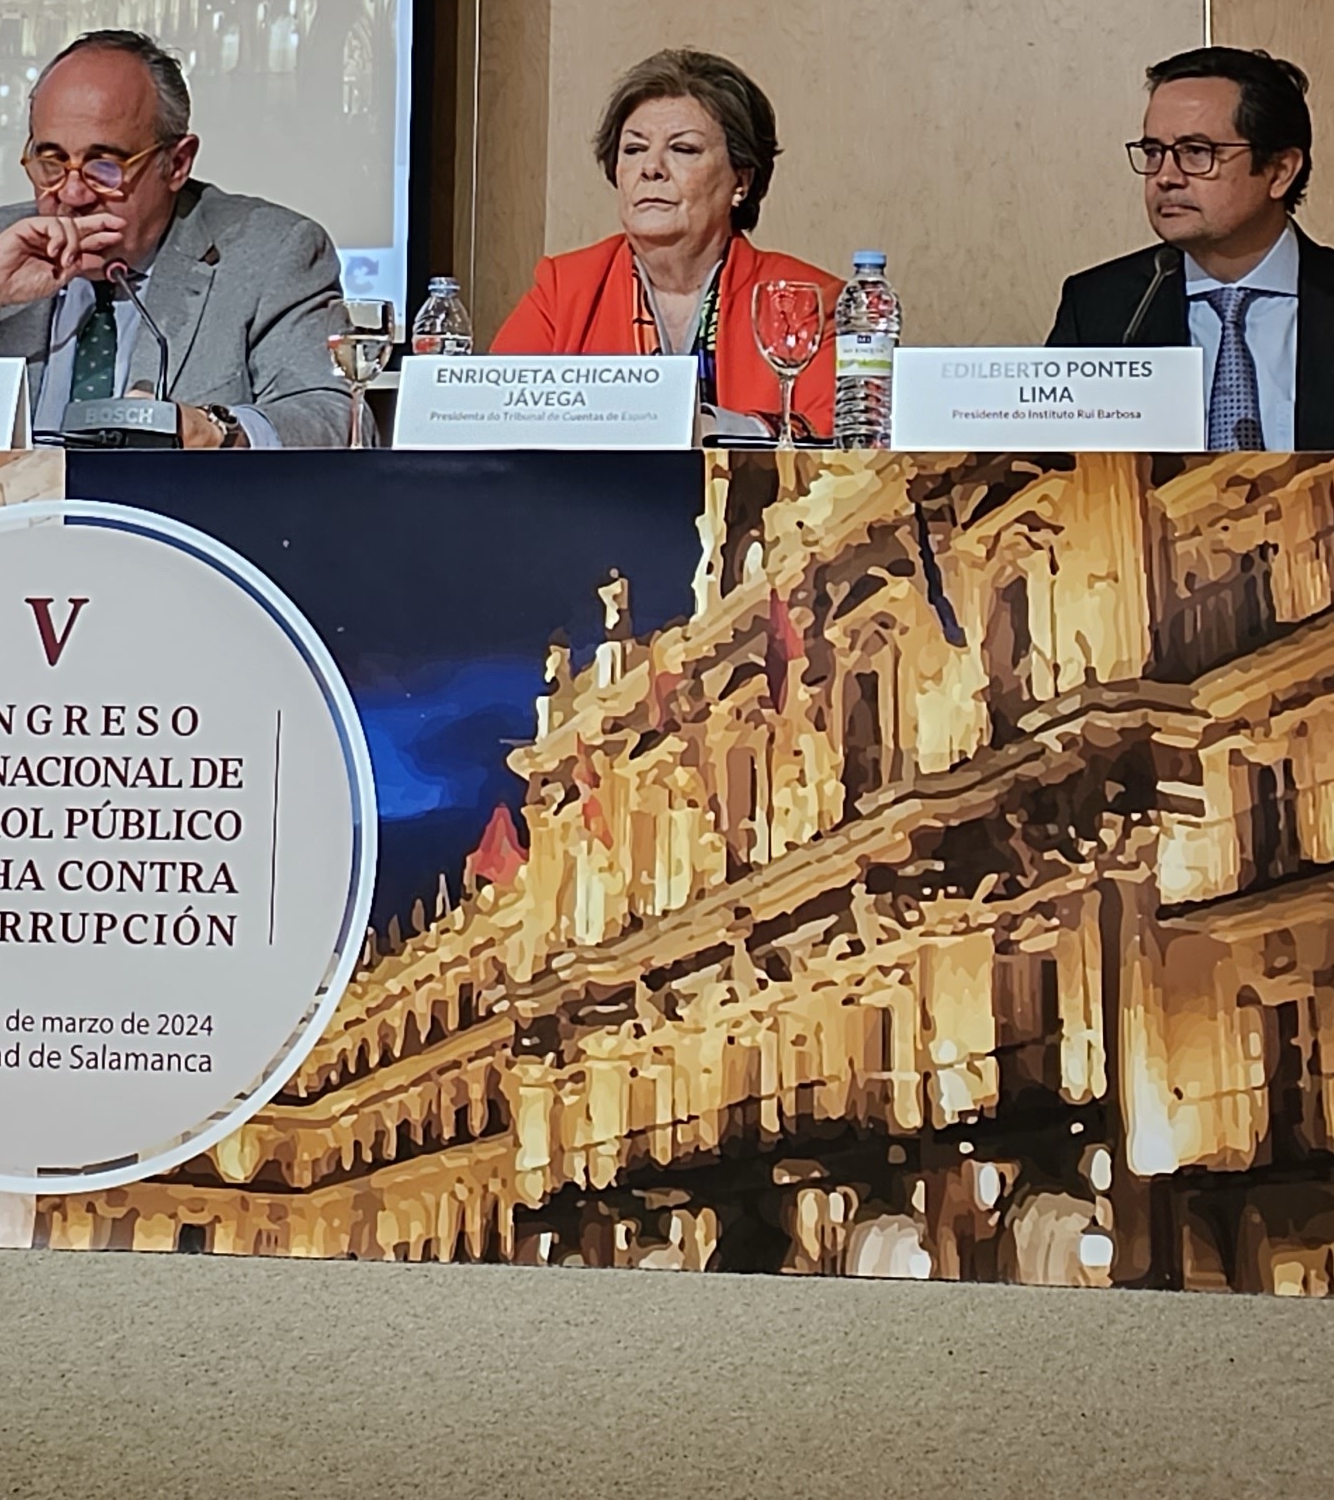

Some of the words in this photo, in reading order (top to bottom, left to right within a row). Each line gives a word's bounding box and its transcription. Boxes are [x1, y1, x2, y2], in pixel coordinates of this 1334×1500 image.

[436, 368, 557, 386] ENRIQUETA
[561, 368, 660, 384] CHICANO
[941, 361, 1061, 379] EDILBERTO
[1067, 360, 1153, 378] PONTES
[503, 388, 586, 407] JÁVEGA
[1019, 386, 1074, 403] LIMA
[85, 407, 154, 424] BOSCH
[430, 411, 485, 421] Presidenta
[503, 411, 545, 421] Tribunal
[547, 411, 560, 421] de
[563, 411, 604, 421] Cuentas
[606, 411, 619, 421] de
[952, 409, 1009, 420] Presidente
[1012, 409, 1026, 420] do
[1028, 409, 1075, 420] Instituto
[1077, 409, 1095, 420] Rui
[1097, 409, 1141, 420] Barbosa
[25, 598, 89, 666] V
[190, 758, 244, 789] DE
[63, 801, 243, 842] PÚBLICO
[57, 861, 239, 895] CONTRA
[5, 1010, 35, 1034] de
[41, 1017, 114, 1036] marzo
[121, 1011, 149, 1035] de
[157, 1014, 214, 1038] 2024
[28, 1043, 62, 1070] de
[69, 1045, 213, 1074] Salamanca
